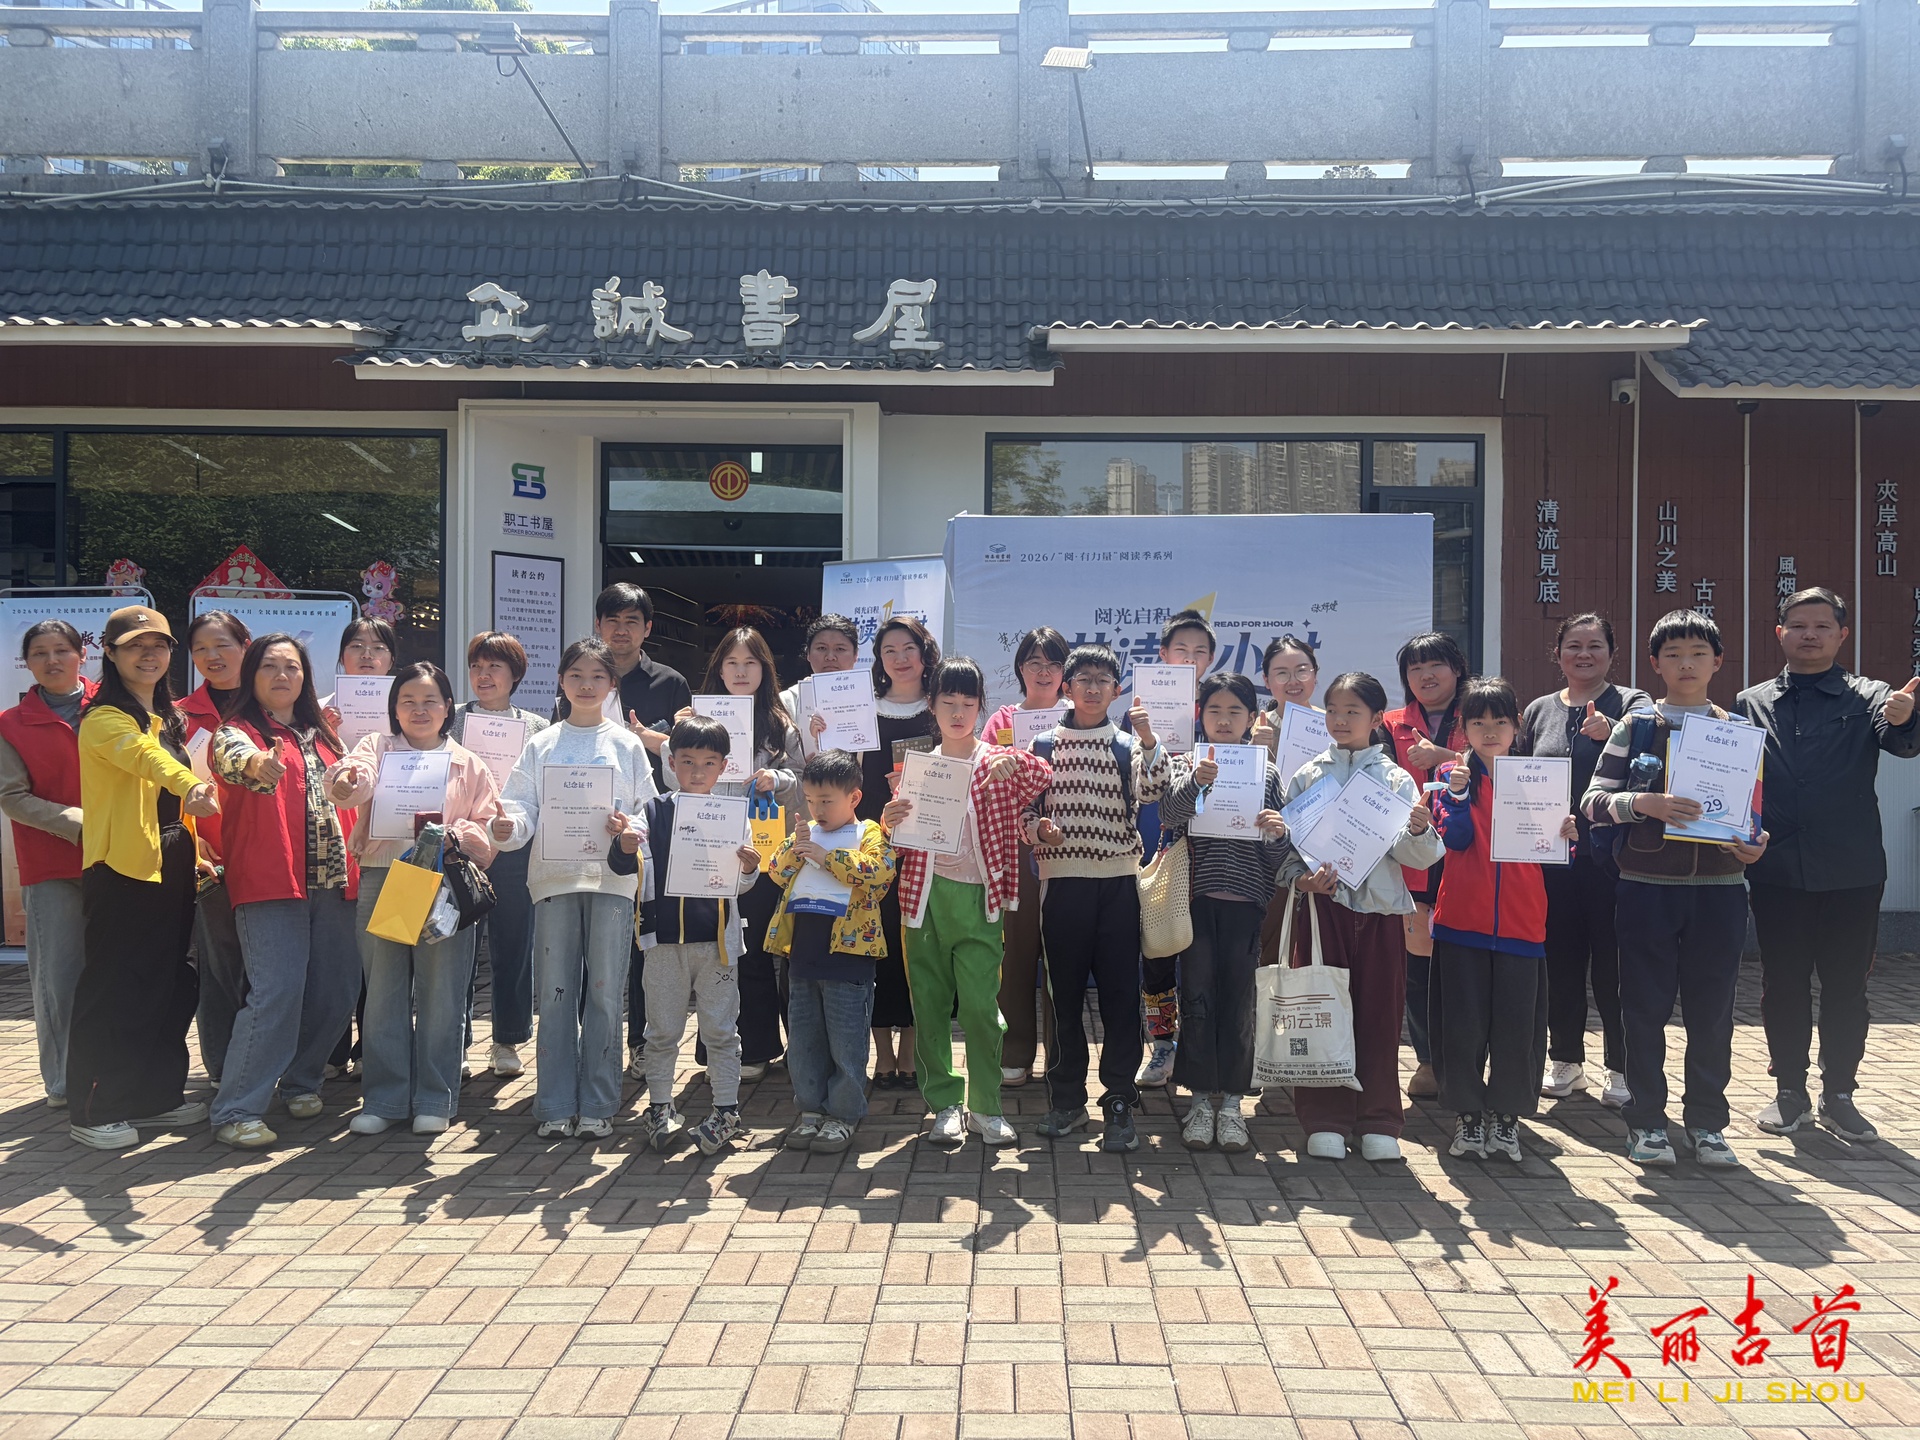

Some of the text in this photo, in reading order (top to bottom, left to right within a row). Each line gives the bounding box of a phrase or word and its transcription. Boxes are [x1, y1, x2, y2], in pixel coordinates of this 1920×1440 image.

[504, 513, 553, 531] 职工书屋
[1875, 479, 1899, 577] 夾岸高山
[525, 530, 554, 538] BOOKHOUSE
[1536, 499, 1560, 603] 清流見底
[1655, 501, 1678, 593] 山川之美
[512, 569, 545, 581] 读者公约
[1777, 556, 1797, 611] 風烟
[854, 606, 880, 615] 阅光启程
[1095, 607, 1171, 625] 阅光启程
[1263, 620, 1294, 628] 1HOUR
[830, 684, 855, 692] 纪念证书
[1151, 679, 1177, 687] 纪念证书
[354, 689, 382, 697] 纪念证书
[710, 709, 735, 717] 纪念证书
[482, 729, 508, 738] 纪念证书
[1304, 725, 1328, 738] 纪念证书
[1705, 734, 1738, 748] 纪念证书
[923, 769, 952, 780] 纪念证书
[1516, 775, 1548, 783] 纪念证书
[563, 781, 593, 789] 纪念证书
[1362, 794, 1390, 816] 纪念证书
[1703, 798, 1723, 813] 29
[696, 812, 727, 821] 纪念证书
